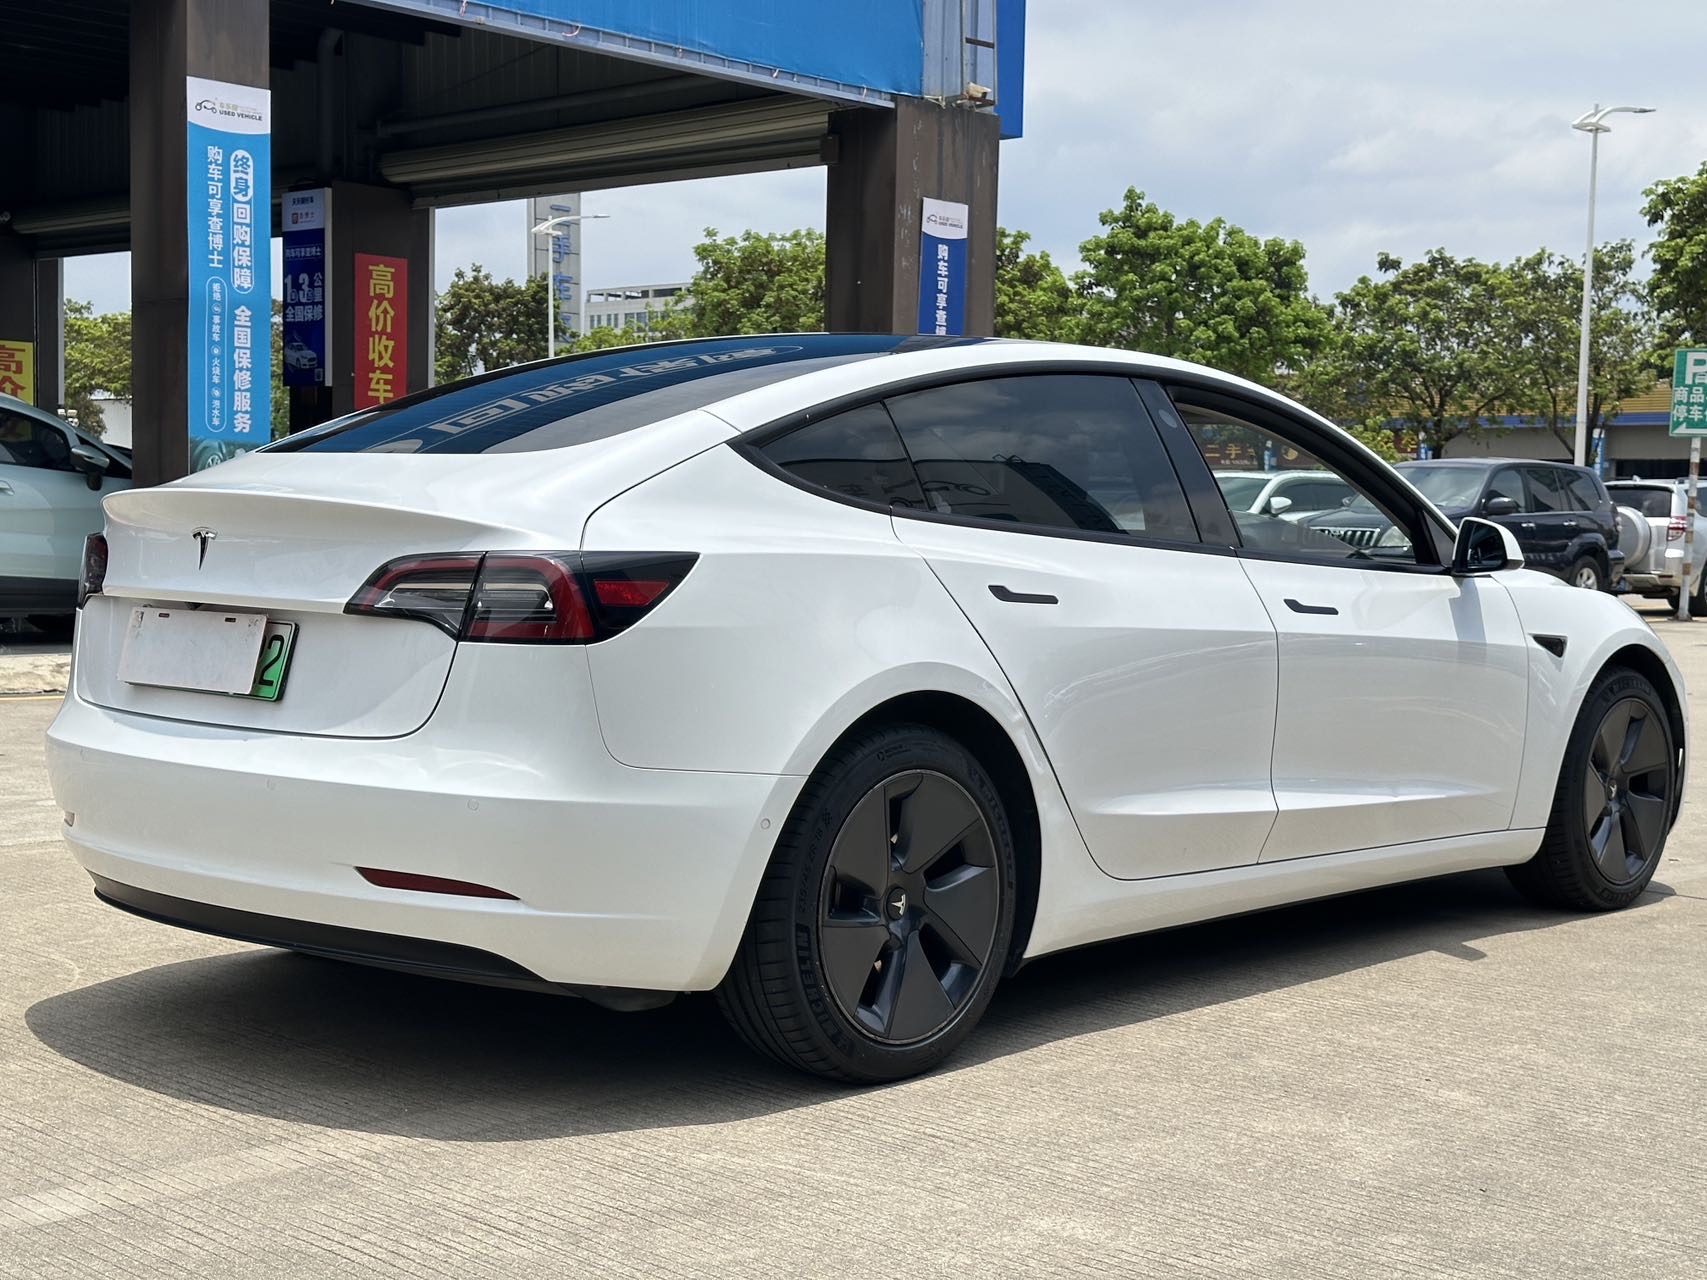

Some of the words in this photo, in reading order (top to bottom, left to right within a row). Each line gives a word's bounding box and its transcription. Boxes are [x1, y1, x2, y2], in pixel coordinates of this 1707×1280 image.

[219, 109, 236, 117] USED
[236, 112, 263, 122] VEHICLE
[207, 146, 223, 268] 购车可享查博士
[285, 305, 323, 322] 全国保修
[368, 264, 395, 405] 高价收车
[211, 357, 220, 384] 火烧车
[233, 305, 252, 433] 全国保修服务
[1674, 386, 1707, 404] 商品
[1672, 405, 1707, 422] 停车
